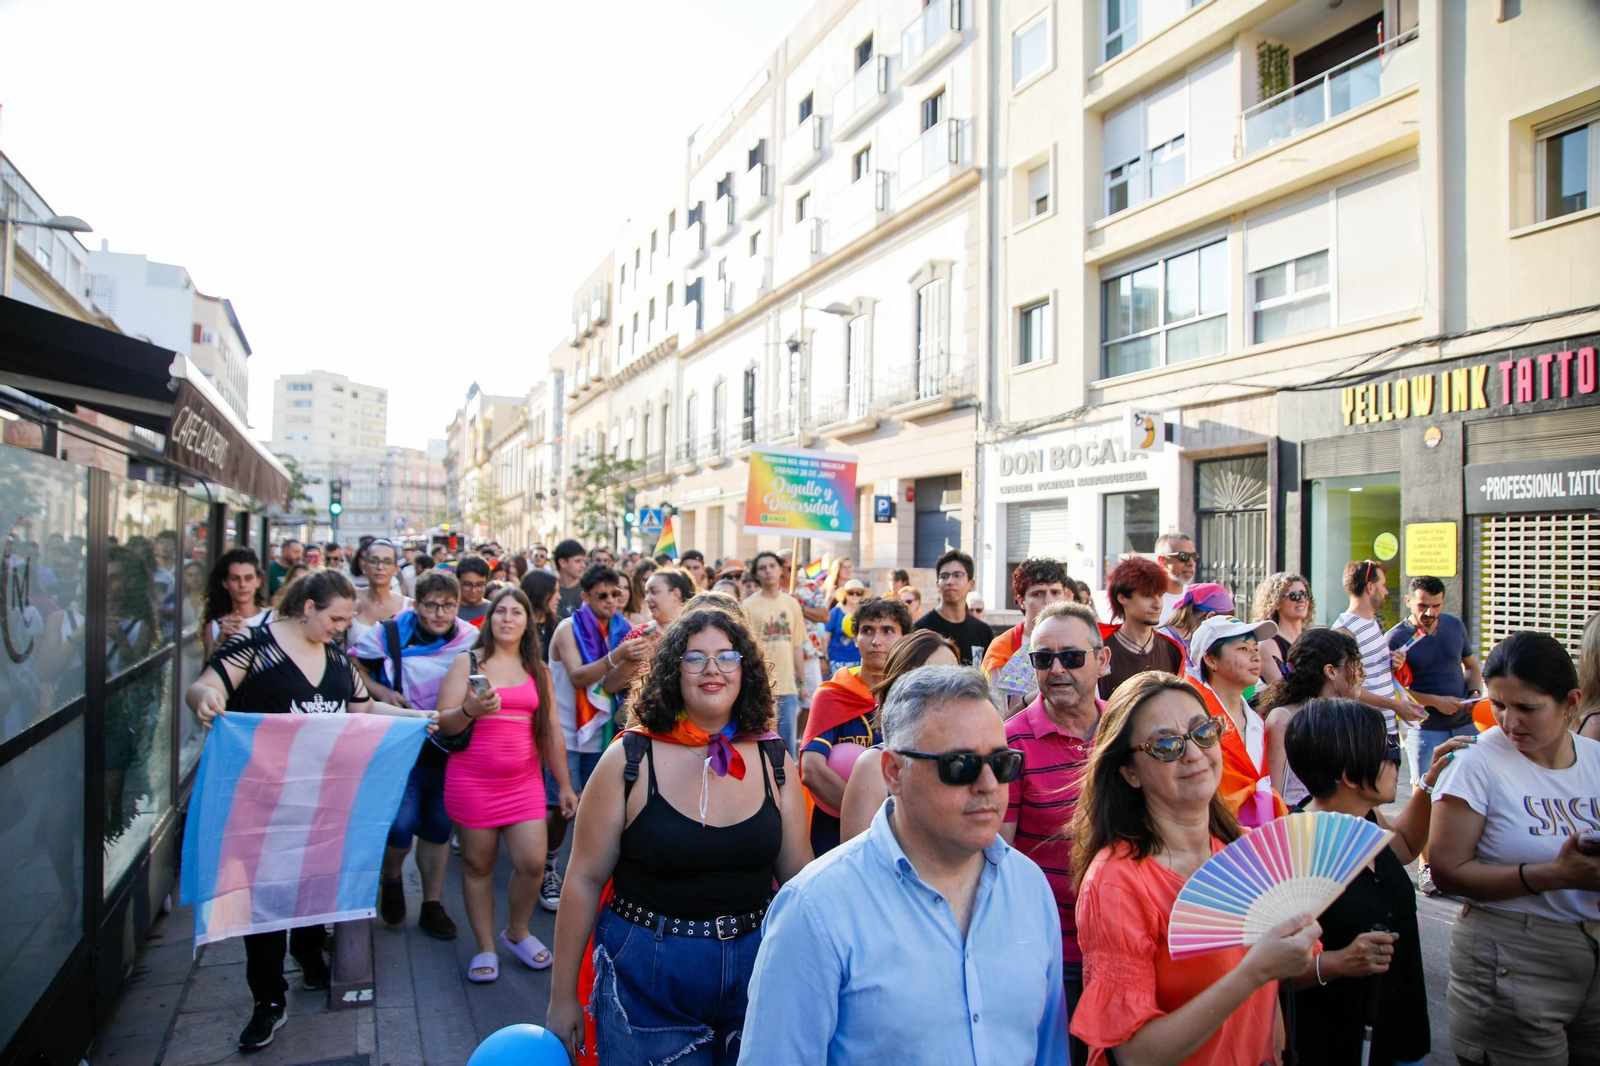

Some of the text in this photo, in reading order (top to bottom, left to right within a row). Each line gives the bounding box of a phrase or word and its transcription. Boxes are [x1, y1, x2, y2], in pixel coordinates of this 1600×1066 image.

[1341, 346, 1596, 426] YELLOW INK TATTO
[1000, 449, 1044, 477] DON
[772, 476, 833, 500] Orgullo y
[1486, 472, 1566, 500] PROFESSIONAL
[763, 493, 839, 517] Diversidad
[878, 499, 888, 512] P
